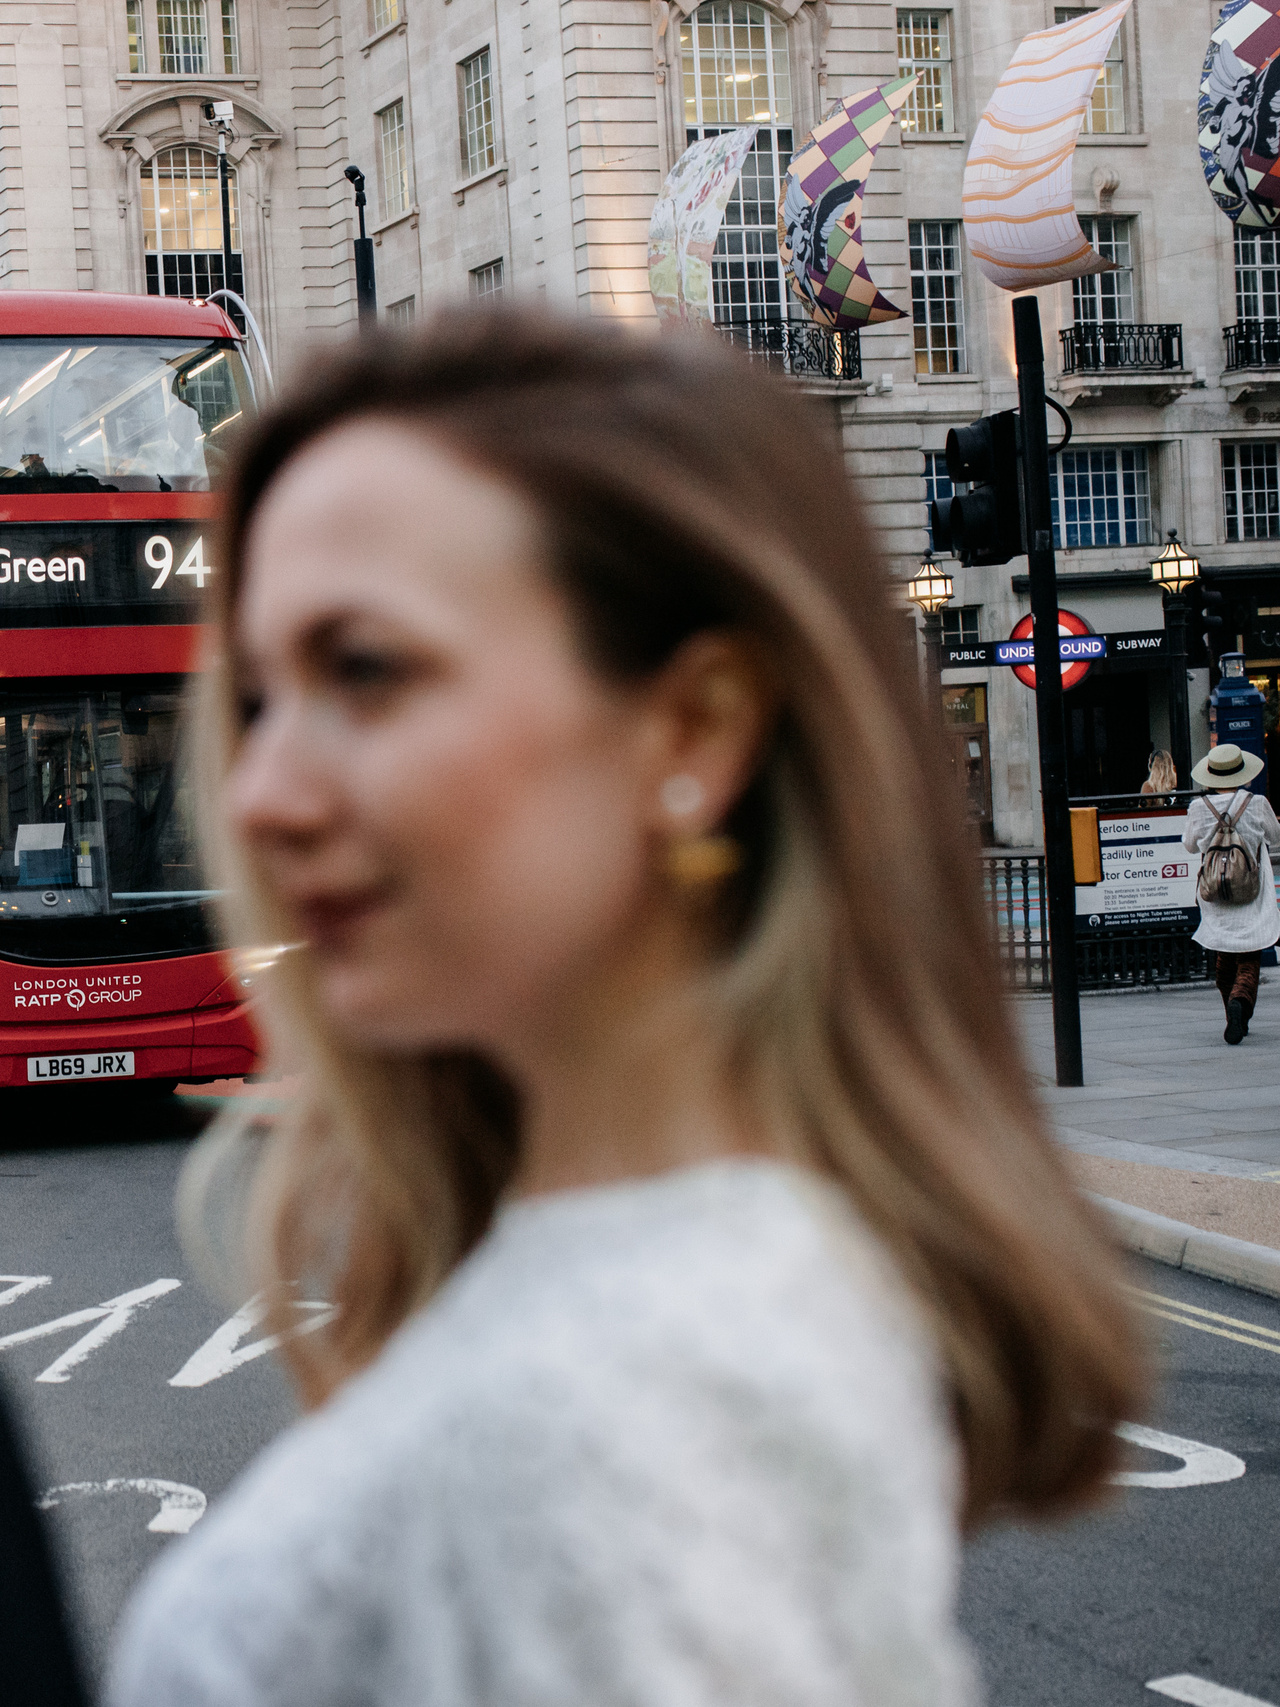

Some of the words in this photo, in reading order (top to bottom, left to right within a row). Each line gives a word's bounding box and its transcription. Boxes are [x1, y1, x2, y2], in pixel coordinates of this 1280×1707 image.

[144, 535, 212, 590] 94
[949, 650, 986, 661] PUBLIC
[999, 642, 1102, 659] UNDEOUND
[1116, 638, 1162, 650] SUBWAY
[1229, 720, 1251, 731] POLICE
[1099, 824, 1129, 834] kerloo
[1132, 822, 1151, 832] line
[1101, 849, 1133, 860] cadilly
[1136, 848, 1154, 858] line
[1102, 871, 1120, 880] itor
[1123, 869, 1158, 879] Centre
[13, 978, 78, 990] LONDON
[85, 975, 142, 987] UNITED
[14, 993, 62, 1007] RATP
[88, 989, 142, 1004] GROUP
[35, 1057, 85, 1078] LB69
[91, 1055, 127, 1075] JRX
